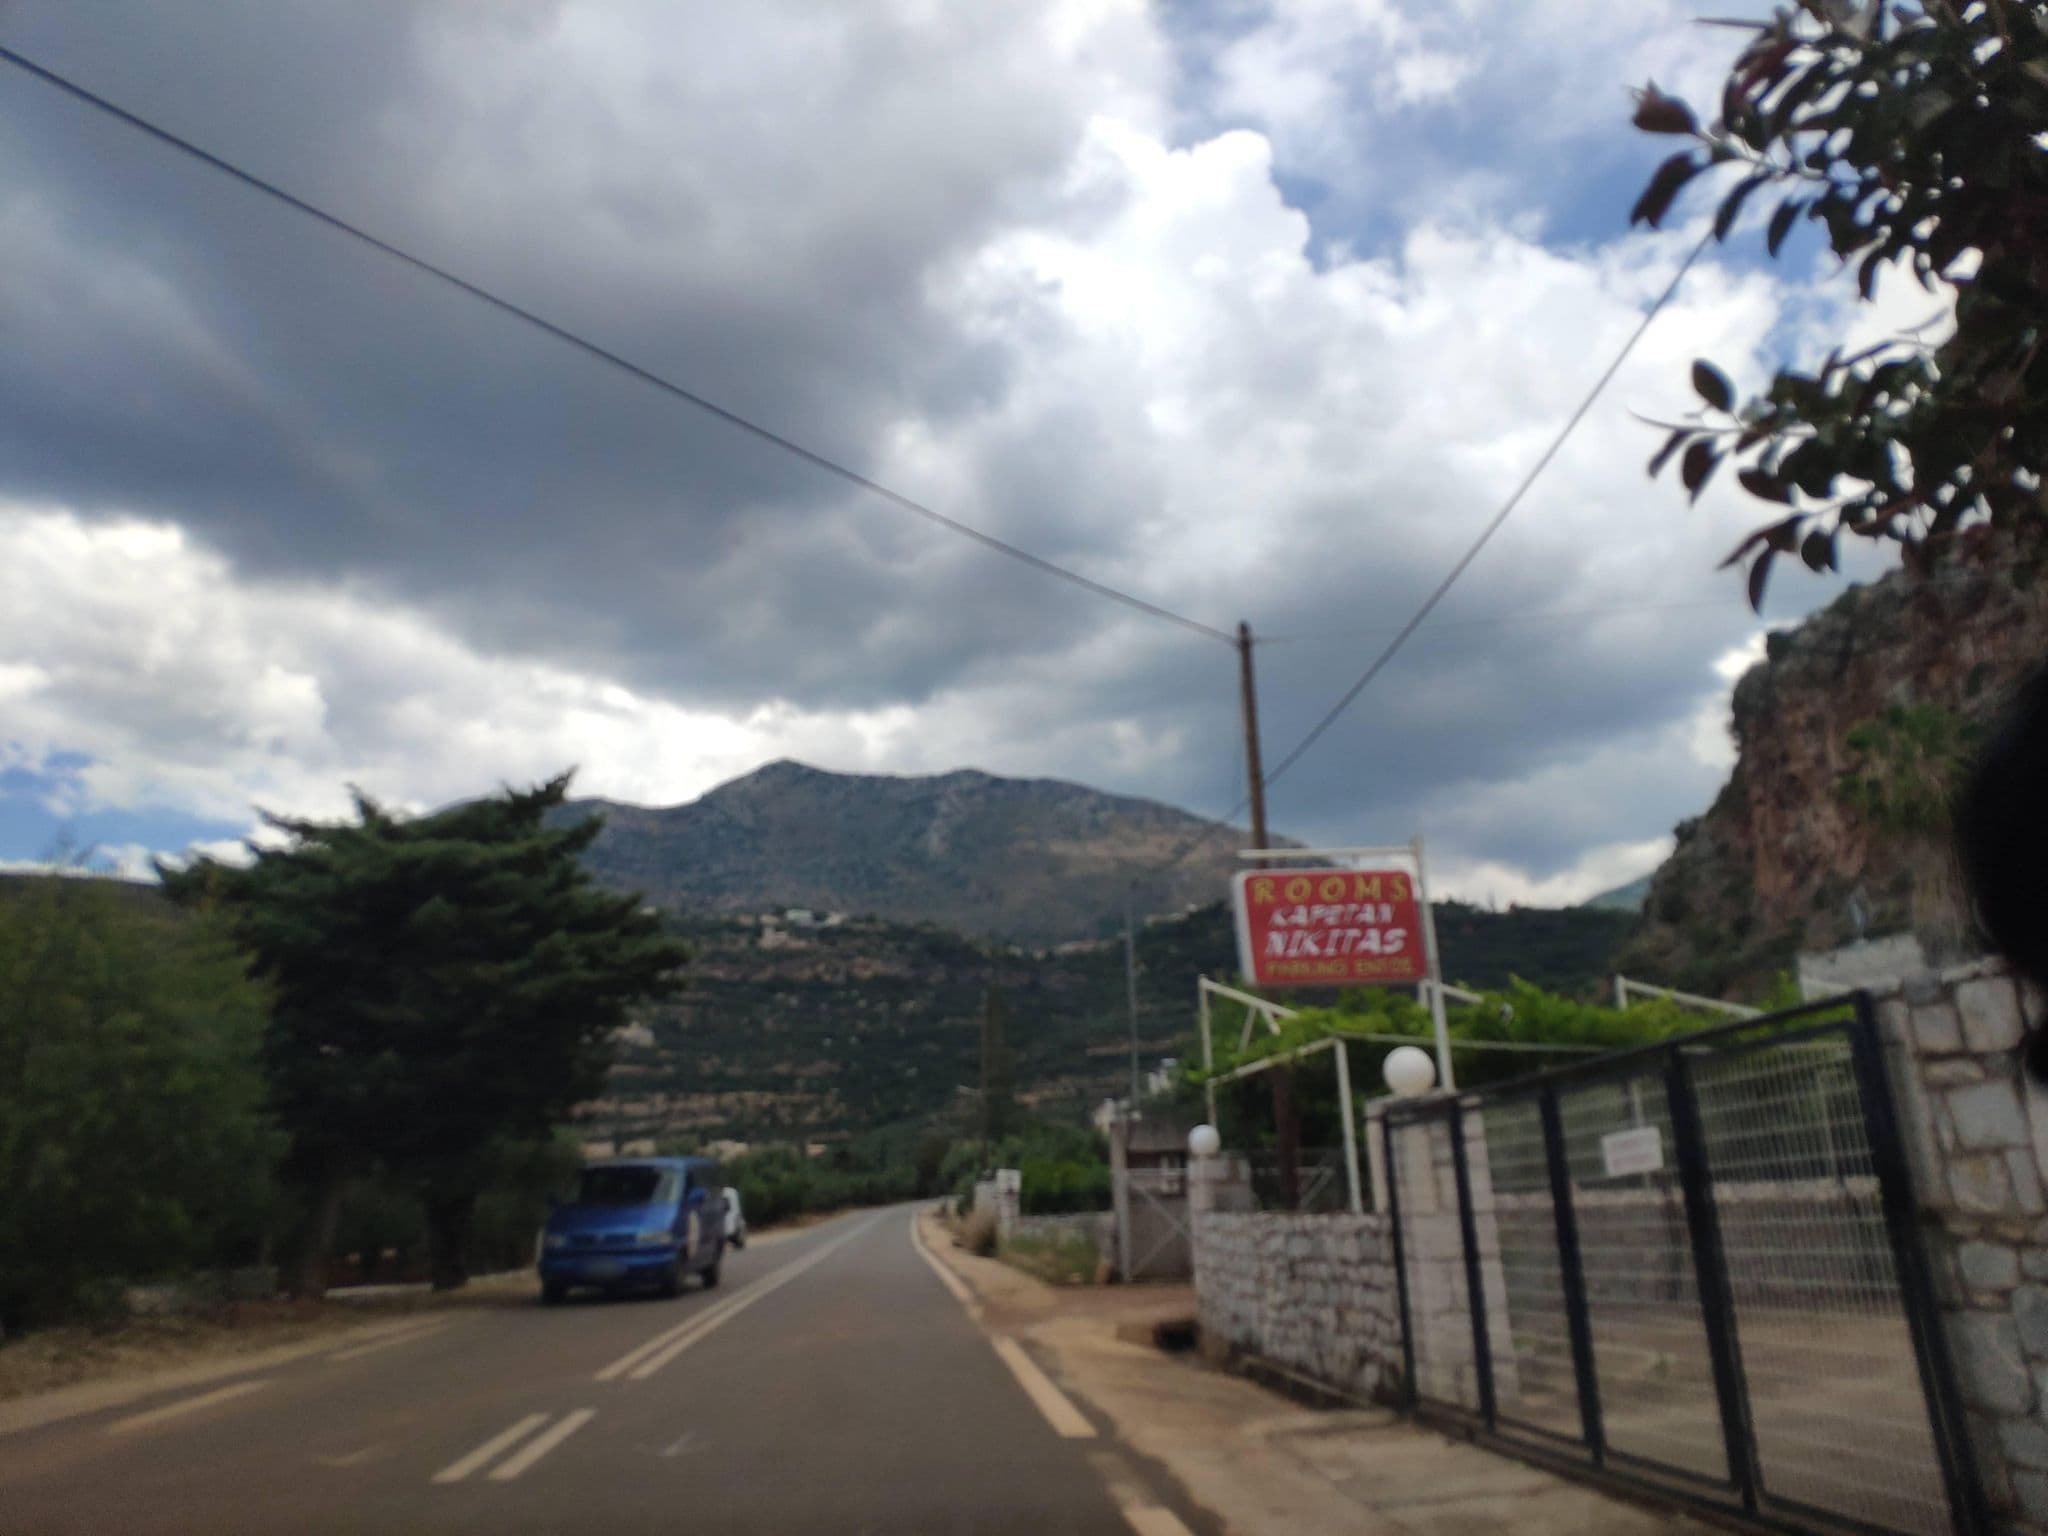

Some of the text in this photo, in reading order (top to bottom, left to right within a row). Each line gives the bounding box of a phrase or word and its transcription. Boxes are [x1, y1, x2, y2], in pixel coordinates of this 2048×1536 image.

[1252, 875, 1407, 904] ROOMS
[1269, 903, 1396, 927] KAPETAN
[1264, 928, 1407, 957] NIKITAS
